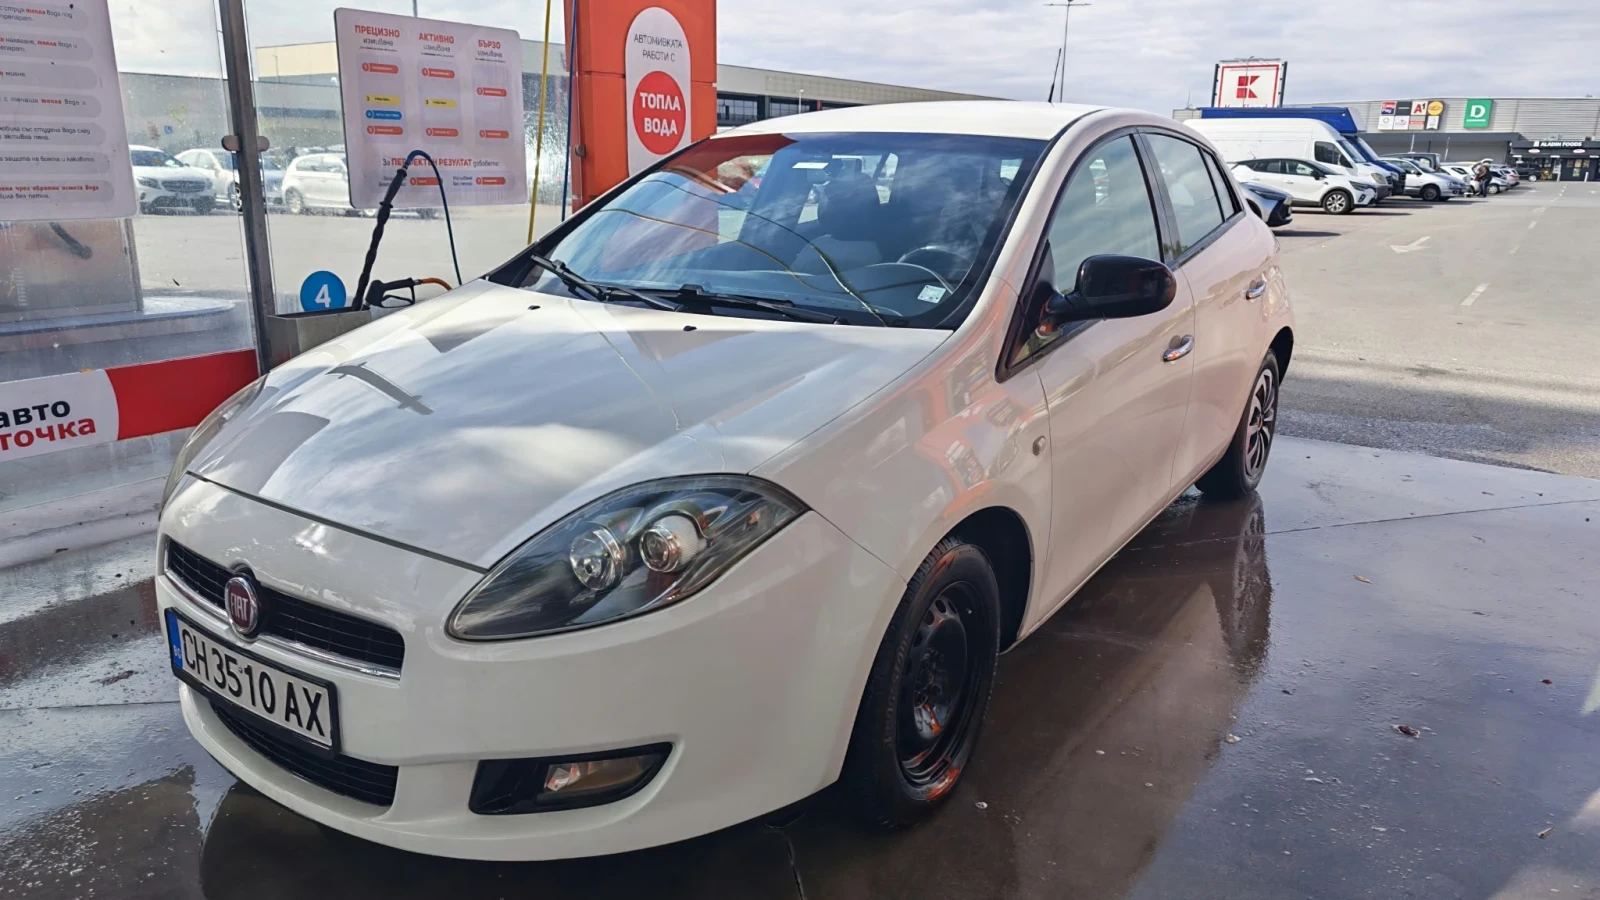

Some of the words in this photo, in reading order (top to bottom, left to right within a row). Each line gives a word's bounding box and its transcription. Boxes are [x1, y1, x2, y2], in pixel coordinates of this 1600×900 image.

[355, 25, 400, 37] ПРЕЦИЗНО
[418, 32, 455, 44] АКТИВНО
[423, 44, 451, 53] измиване
[478, 39, 501, 49] БЪРЗО
[634, 33, 683, 49] АВТОМИВКАТА
[477, 50, 503, 58] измиване
[642, 50, 669, 62] РАБОТИ
[671, 53, 676, 62] С
[640, 92, 681, 111] ТОПЛА
[1470, 105, 1486, 118] D
[644, 117, 678, 137] ВОДА
[391, 158, 438, 167] ПЕРЕКТЕН
[438, 158, 472, 167] РЕЗУЛТАТ
[314, 283, 331, 308] 4
[0, 400, 70, 429] авто
[0, 418, 96, 451] точка
[230, 592, 249, 622] FIAT
[173, 644, 182, 660] BG
[182, 629, 210, 682] CH
[211, 647, 276, 714] 3510
[284, 681, 325, 737] AX
